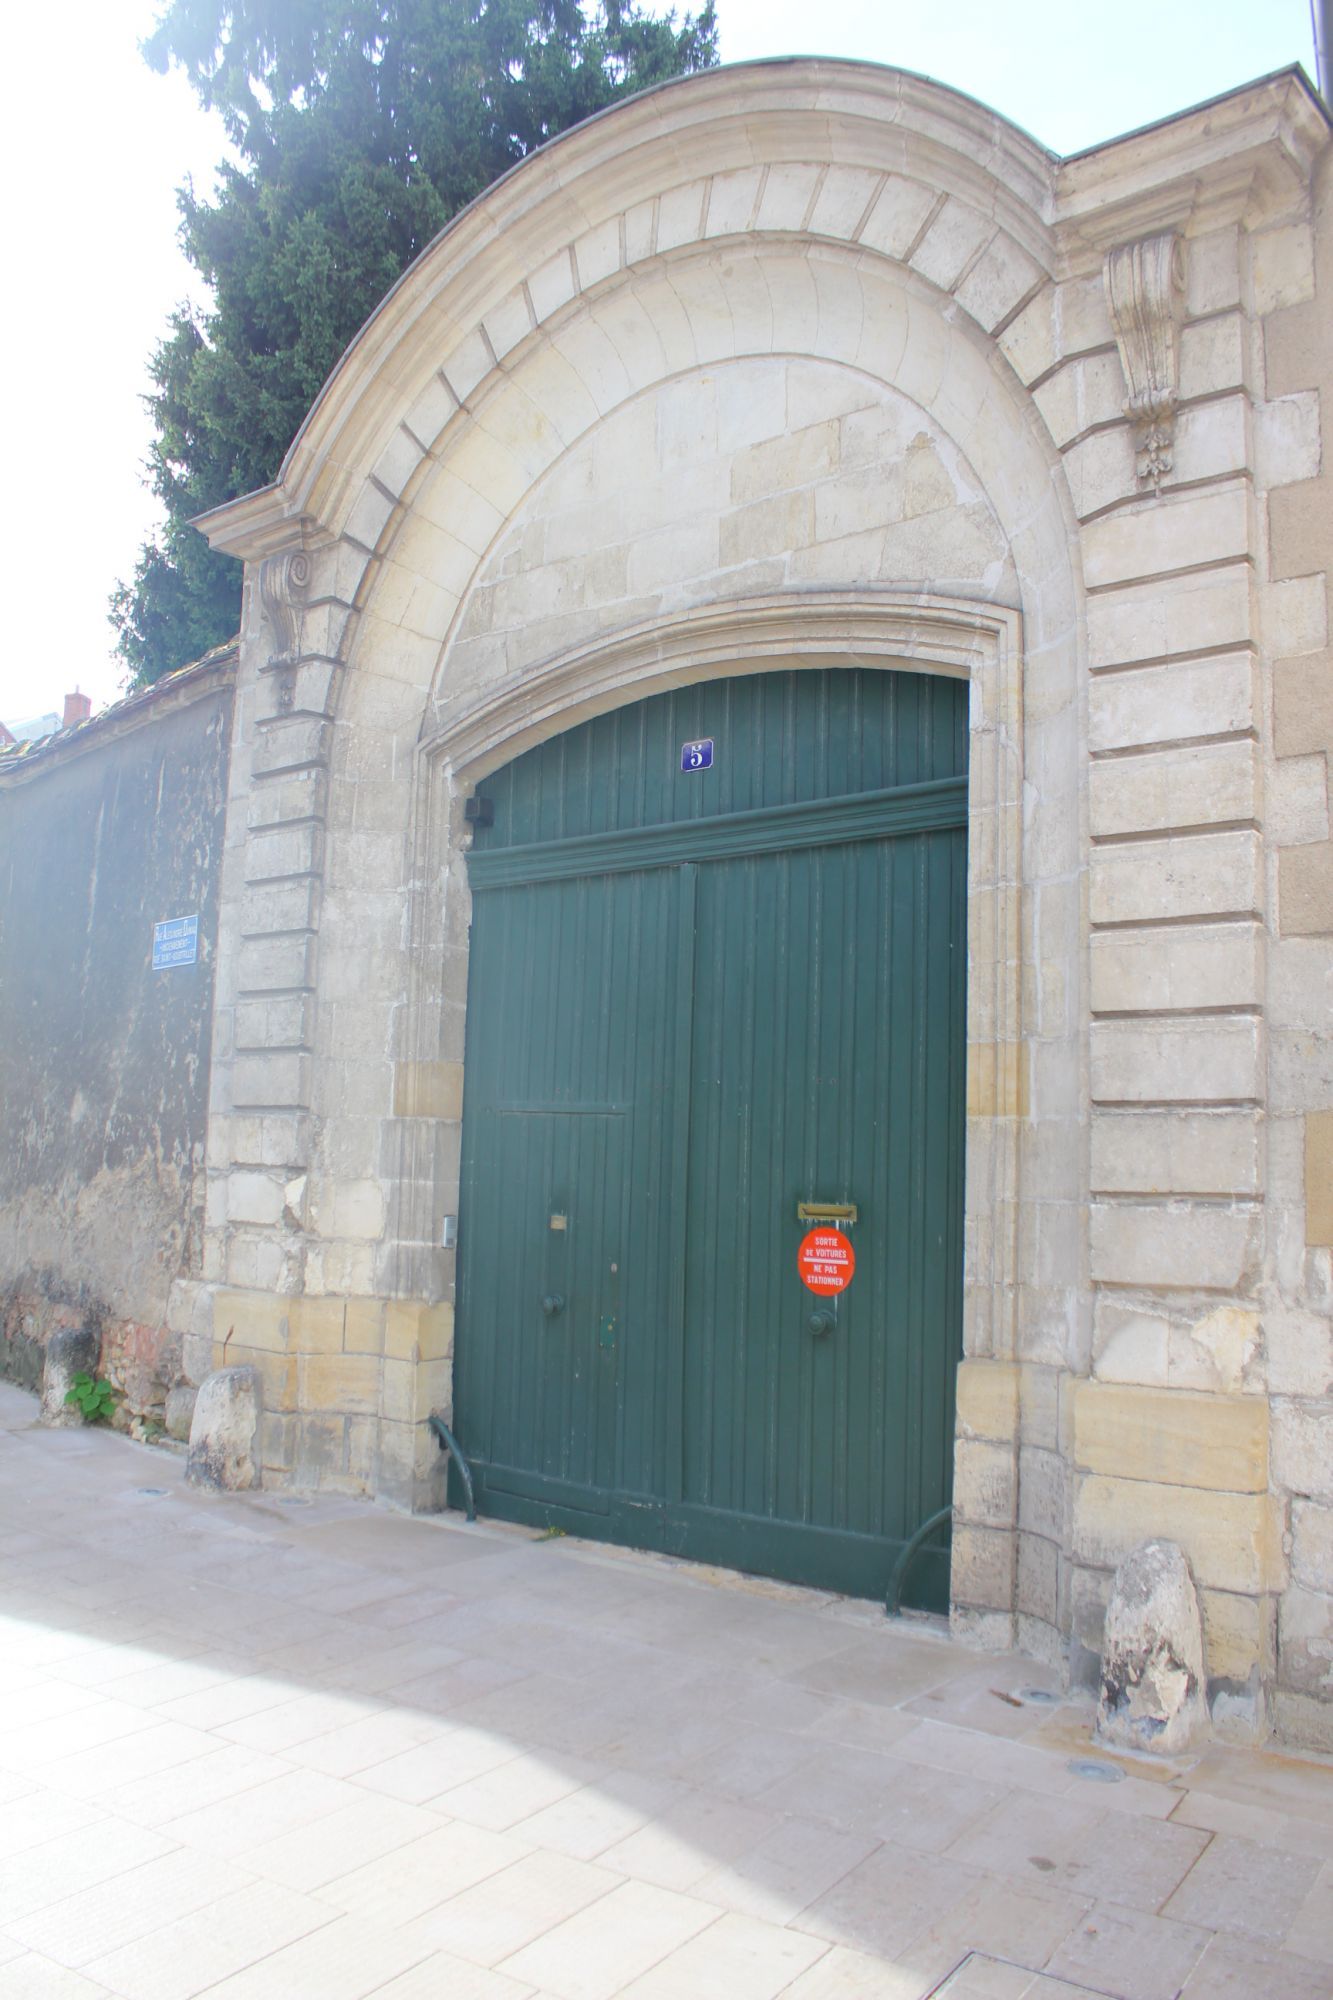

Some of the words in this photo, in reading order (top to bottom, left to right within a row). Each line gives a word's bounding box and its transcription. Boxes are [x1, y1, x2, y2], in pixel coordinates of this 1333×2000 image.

[691, 745, 702, 766] 5
[815, 1237, 837, 1247] SORTIE
[806, 1249, 813, 1257] DE
[816, 1249, 847, 1259] VOITURES
[813, 1264, 821, 1273] NE
[824, 1265, 837, 1274] PAS
[807, 1275, 843, 1286] STATIONNER
